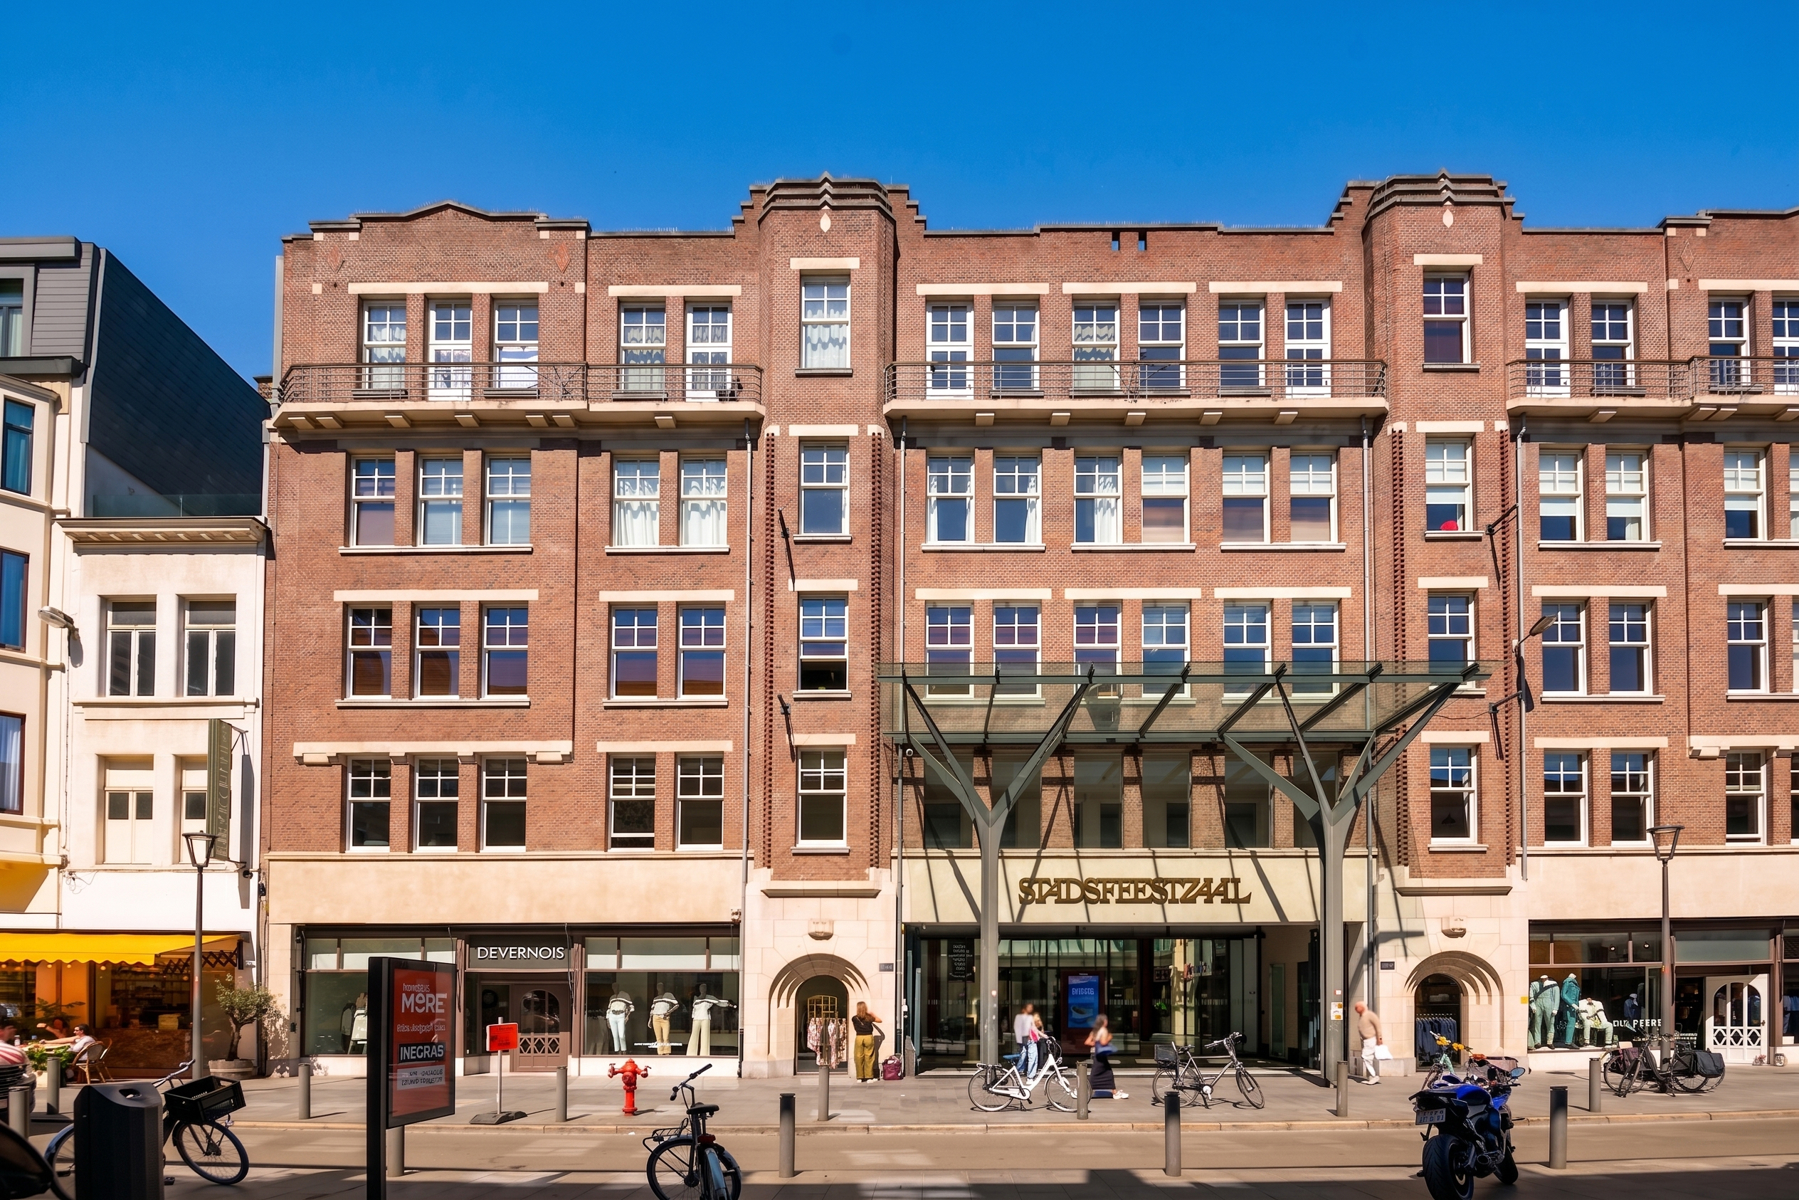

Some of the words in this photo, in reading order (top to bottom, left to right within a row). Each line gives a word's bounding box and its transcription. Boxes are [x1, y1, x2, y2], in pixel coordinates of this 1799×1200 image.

[1018, 877, 1252, 905] STADSFEESTZAAL
[477, 946, 565, 960] DEVERNOIS
[401, 992, 448, 1014] MORE
